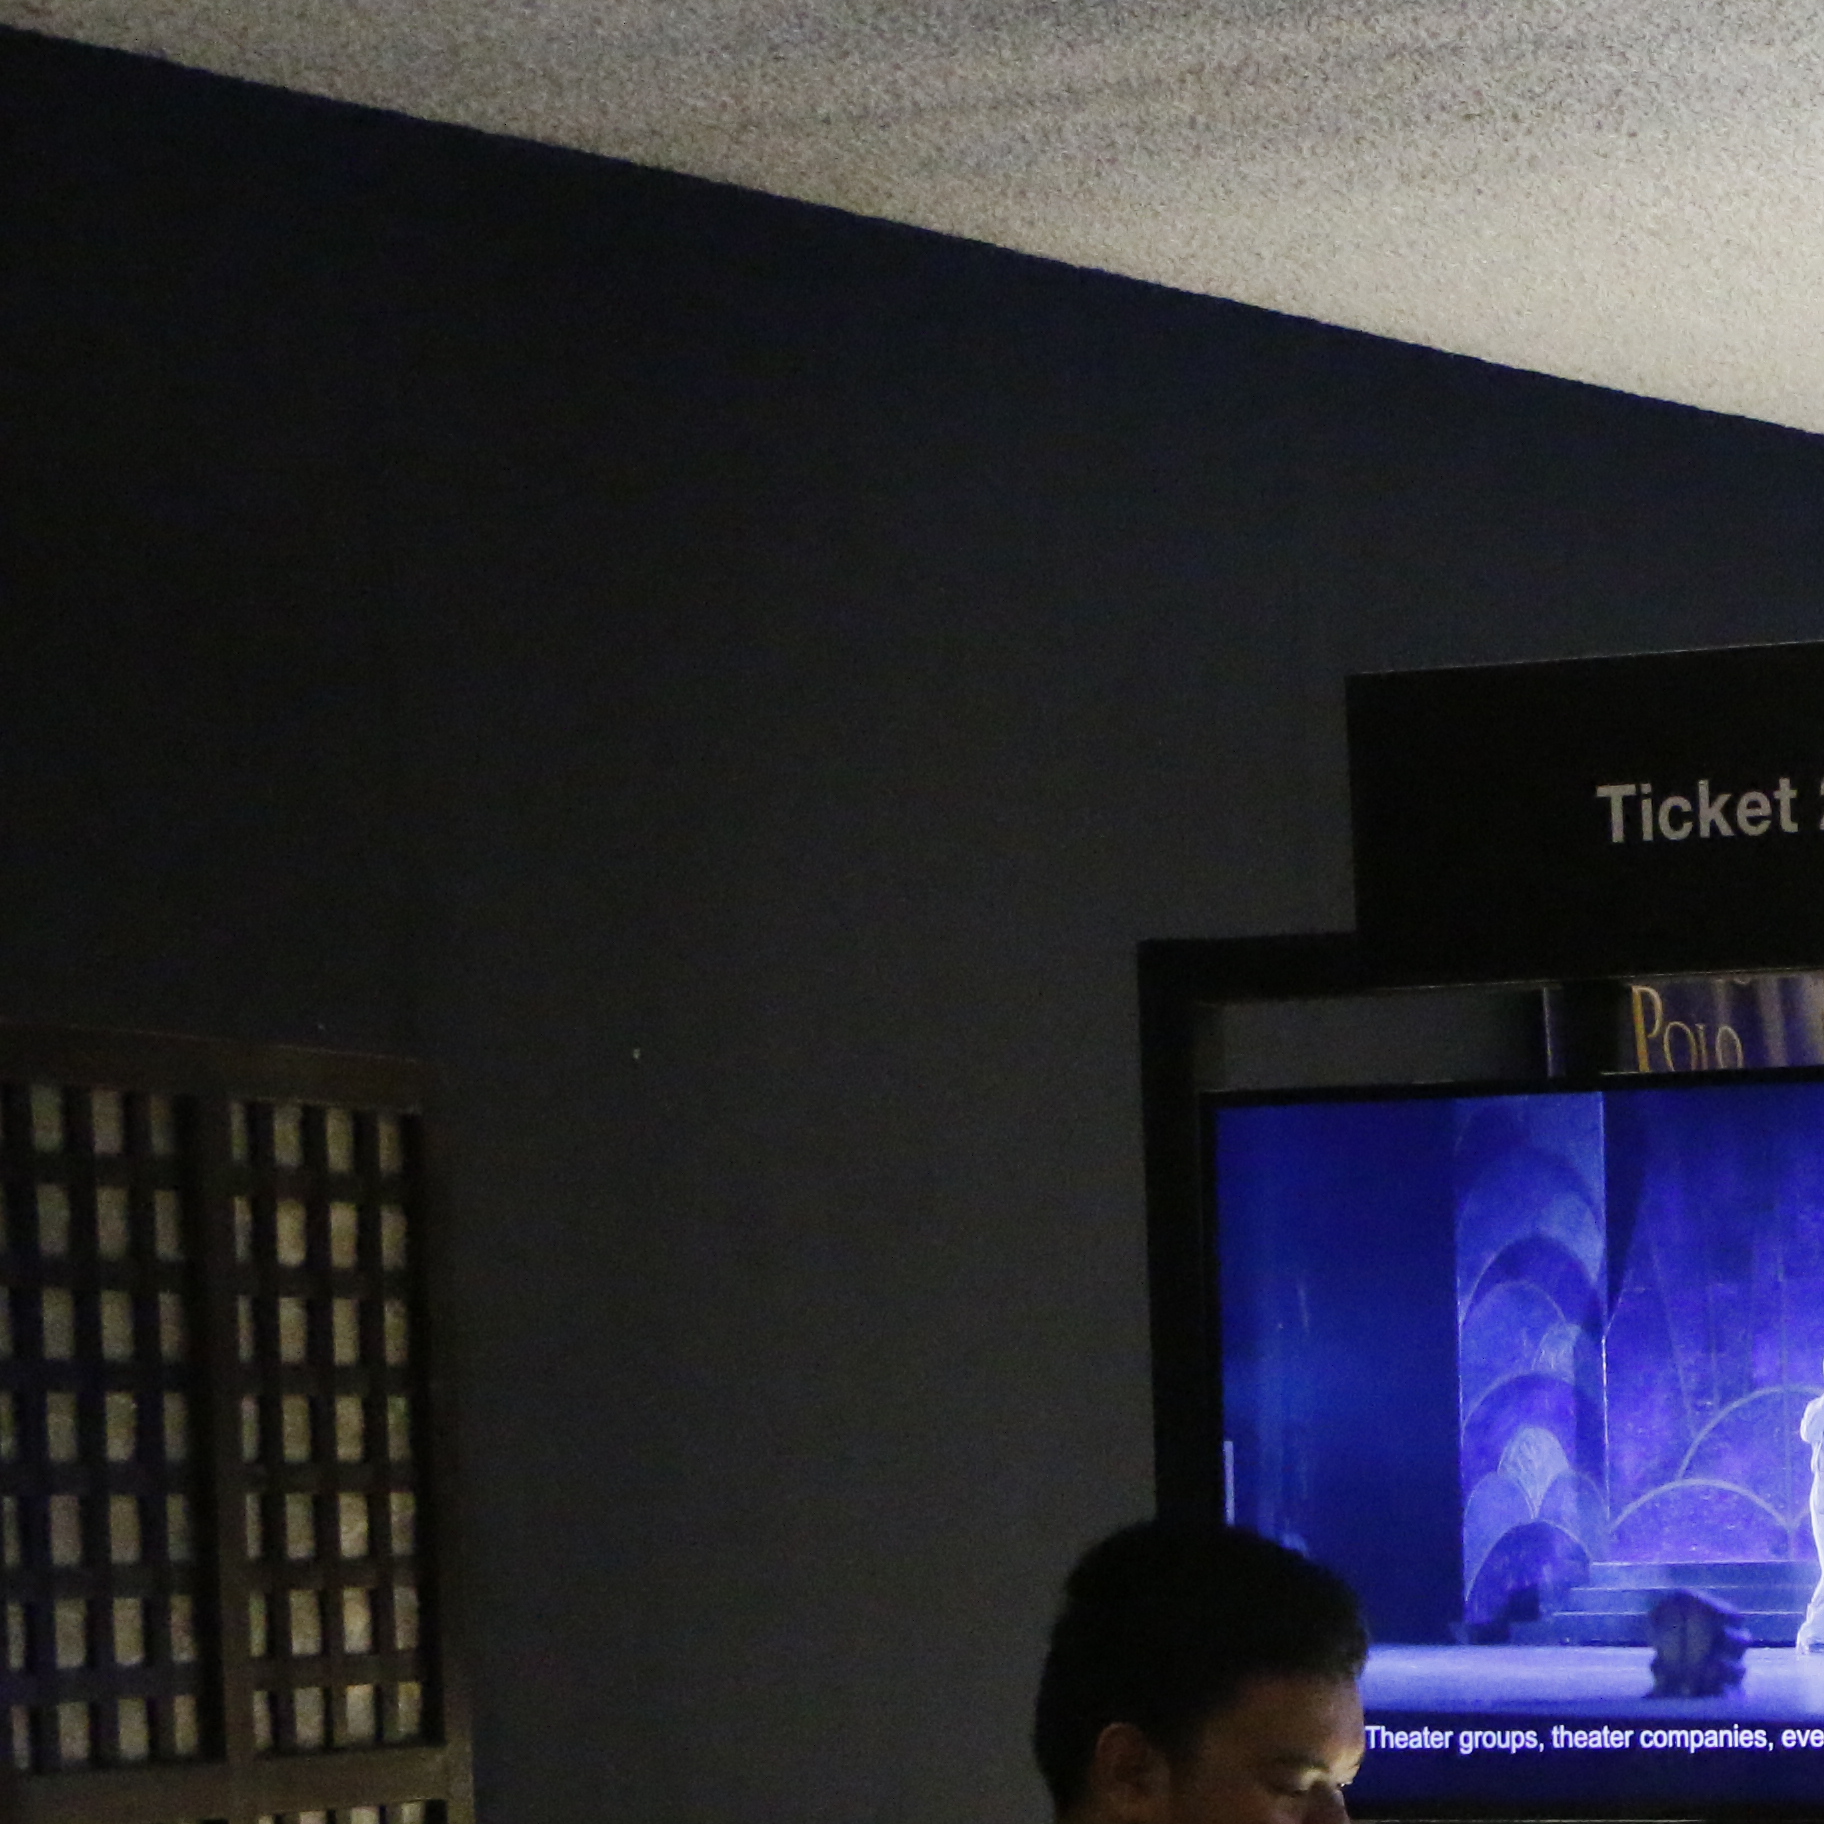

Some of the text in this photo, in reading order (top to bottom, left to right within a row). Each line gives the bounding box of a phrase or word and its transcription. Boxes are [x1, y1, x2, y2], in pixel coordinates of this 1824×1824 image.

[1595, 777, 1799, 844] Ticket
[1364, 1725, 1453, 1749] Theater
[1458, 1729, 1545, 1755] groups,
[1551, 1724, 1634, 1748] theater
[1639, 1723, 1774, 1753] companies,
